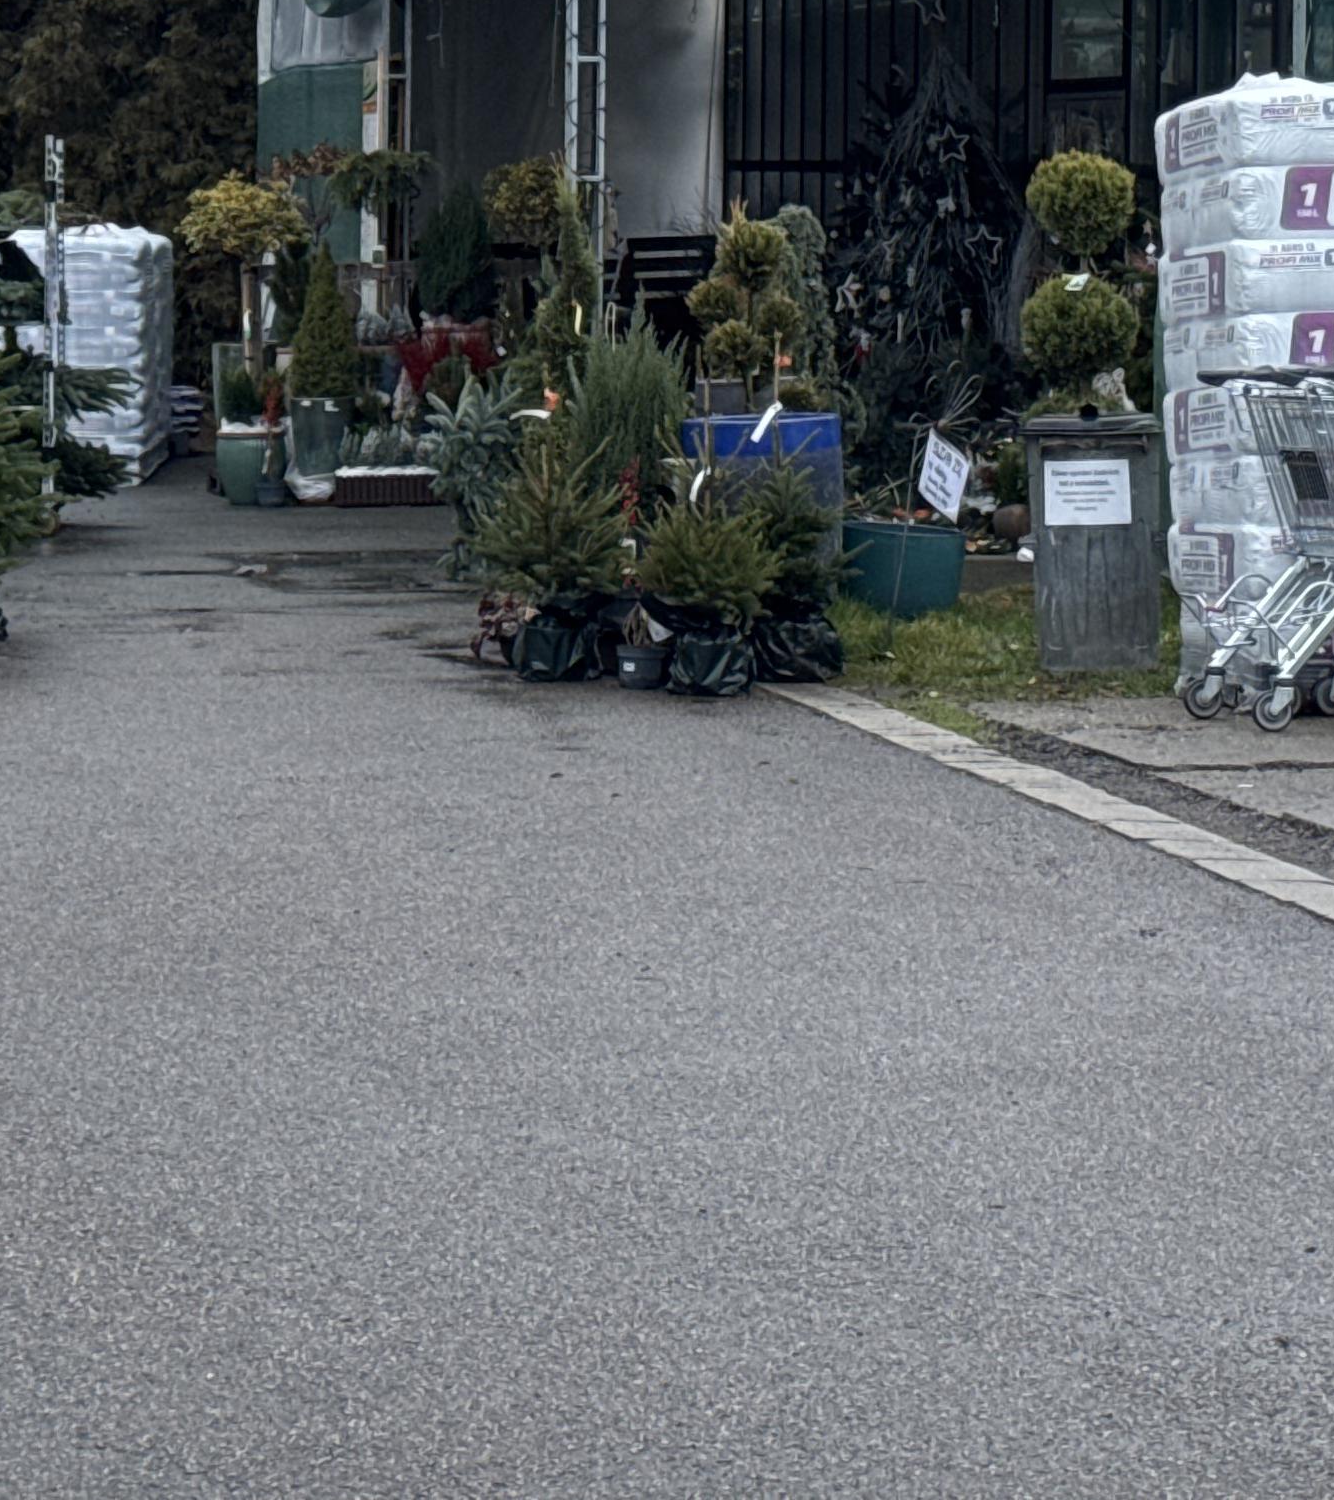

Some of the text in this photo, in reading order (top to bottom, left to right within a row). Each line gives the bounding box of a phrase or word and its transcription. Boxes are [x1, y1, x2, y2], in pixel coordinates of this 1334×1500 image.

[1261, 105, 1295, 117] PROFI
[1300, 183, 1319, 207] 1
[1259, 255, 1297, 266] PROFI
[1211, 272, 1219, 295] 1
[1308, 329, 1327, 353] 1
